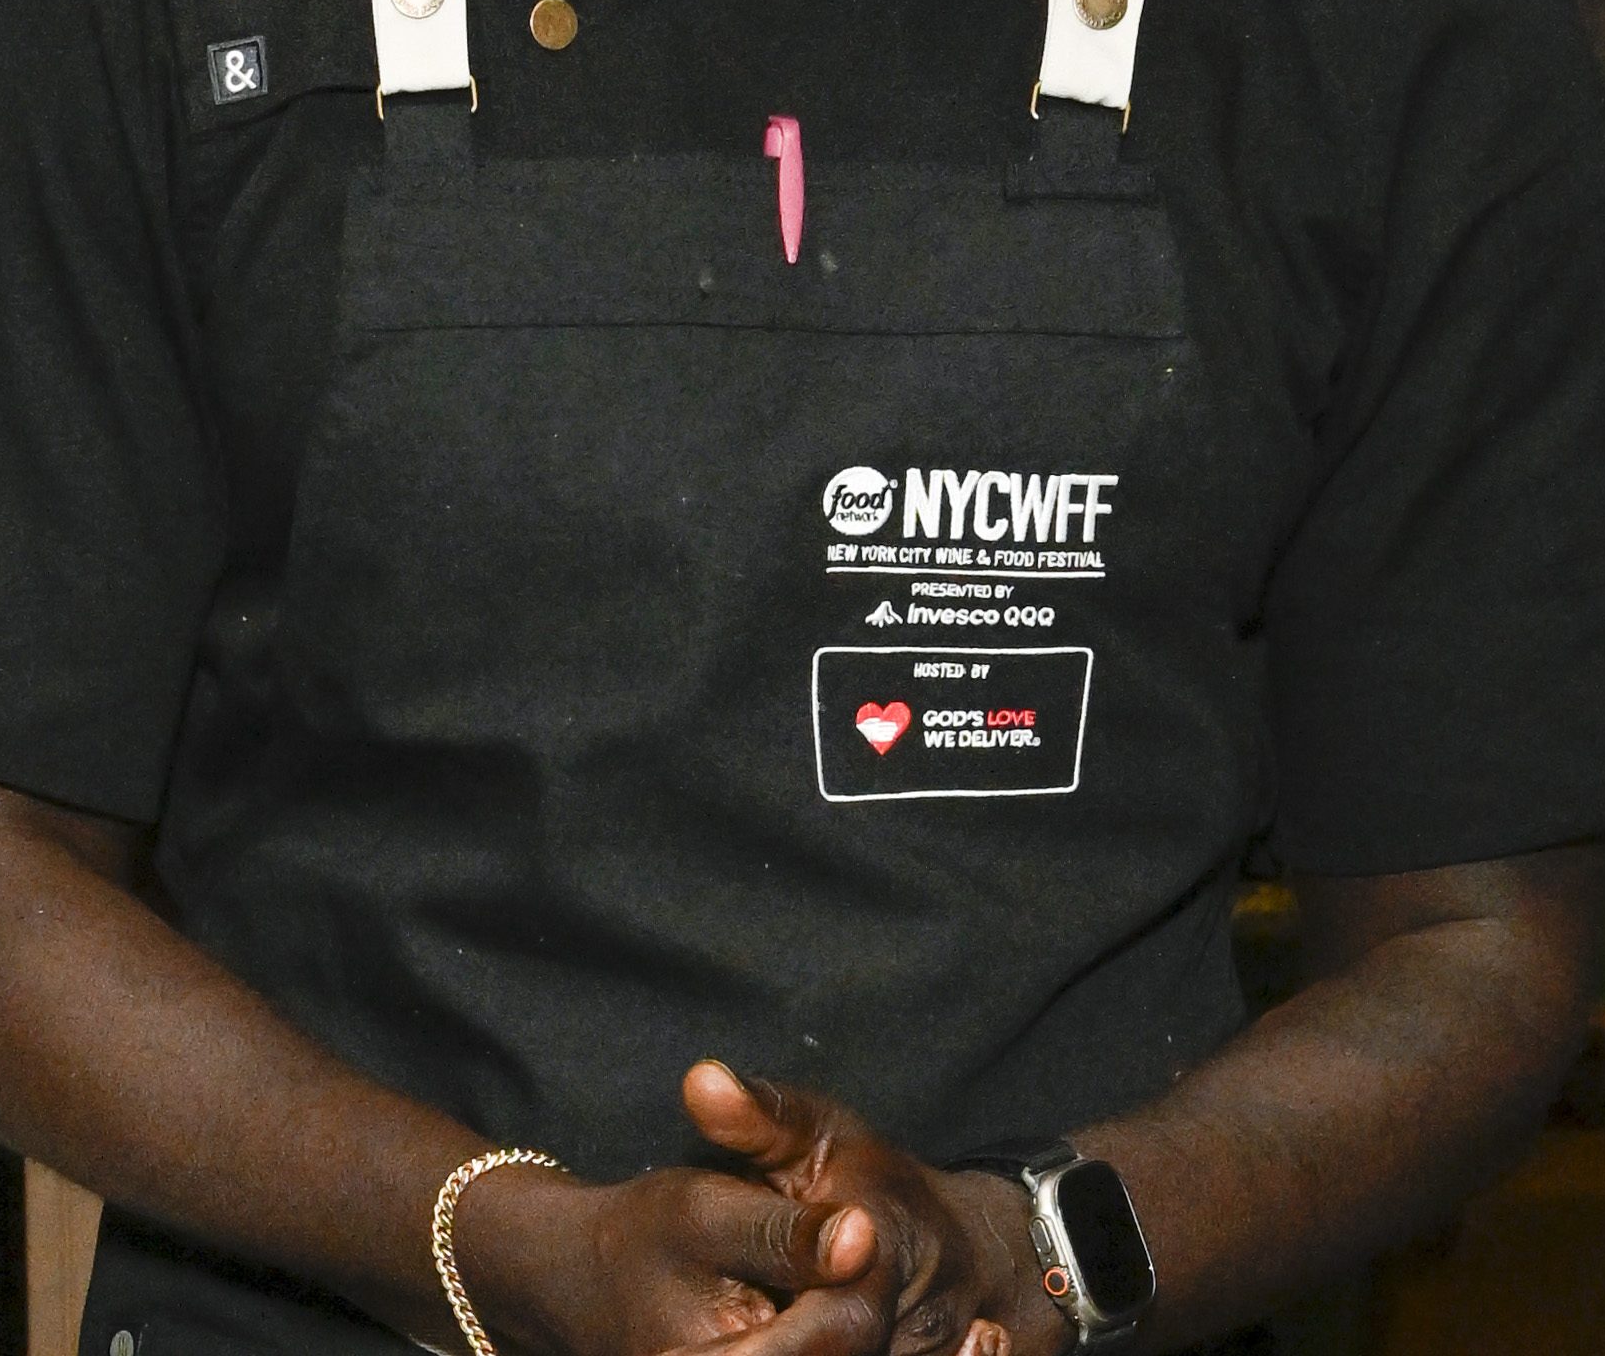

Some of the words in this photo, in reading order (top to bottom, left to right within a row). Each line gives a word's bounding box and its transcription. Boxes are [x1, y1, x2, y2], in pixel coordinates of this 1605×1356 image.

[225, 50, 257, 93] &
[828, 483, 891, 521] food
[902, 467, 1120, 544] NYCWFF
[826, 544, 858, 562] NEW
[861, 545, 897, 563] YORK
[899, 546, 932, 565] CITY
[935, 548, 974, 566] WINE
[976, 549, 992, 566] &
[994, 550, 1035, 568] FOOD
[1037, 550, 1106, 569] FESTIVAL
[911, 582, 992, 599] PRESENTED
[995, 584, 1015, 600] BY
[907, 602, 1000, 626] Invesco
[1004, 605, 1056, 627] QQQ
[913, 662, 966, 679] HOSTED
[970, 663, 991, 680] BY
[922, 710, 985, 727] GOD'S
[987, 709, 1037, 727] LOVE
[923, 730, 957, 748] WE
